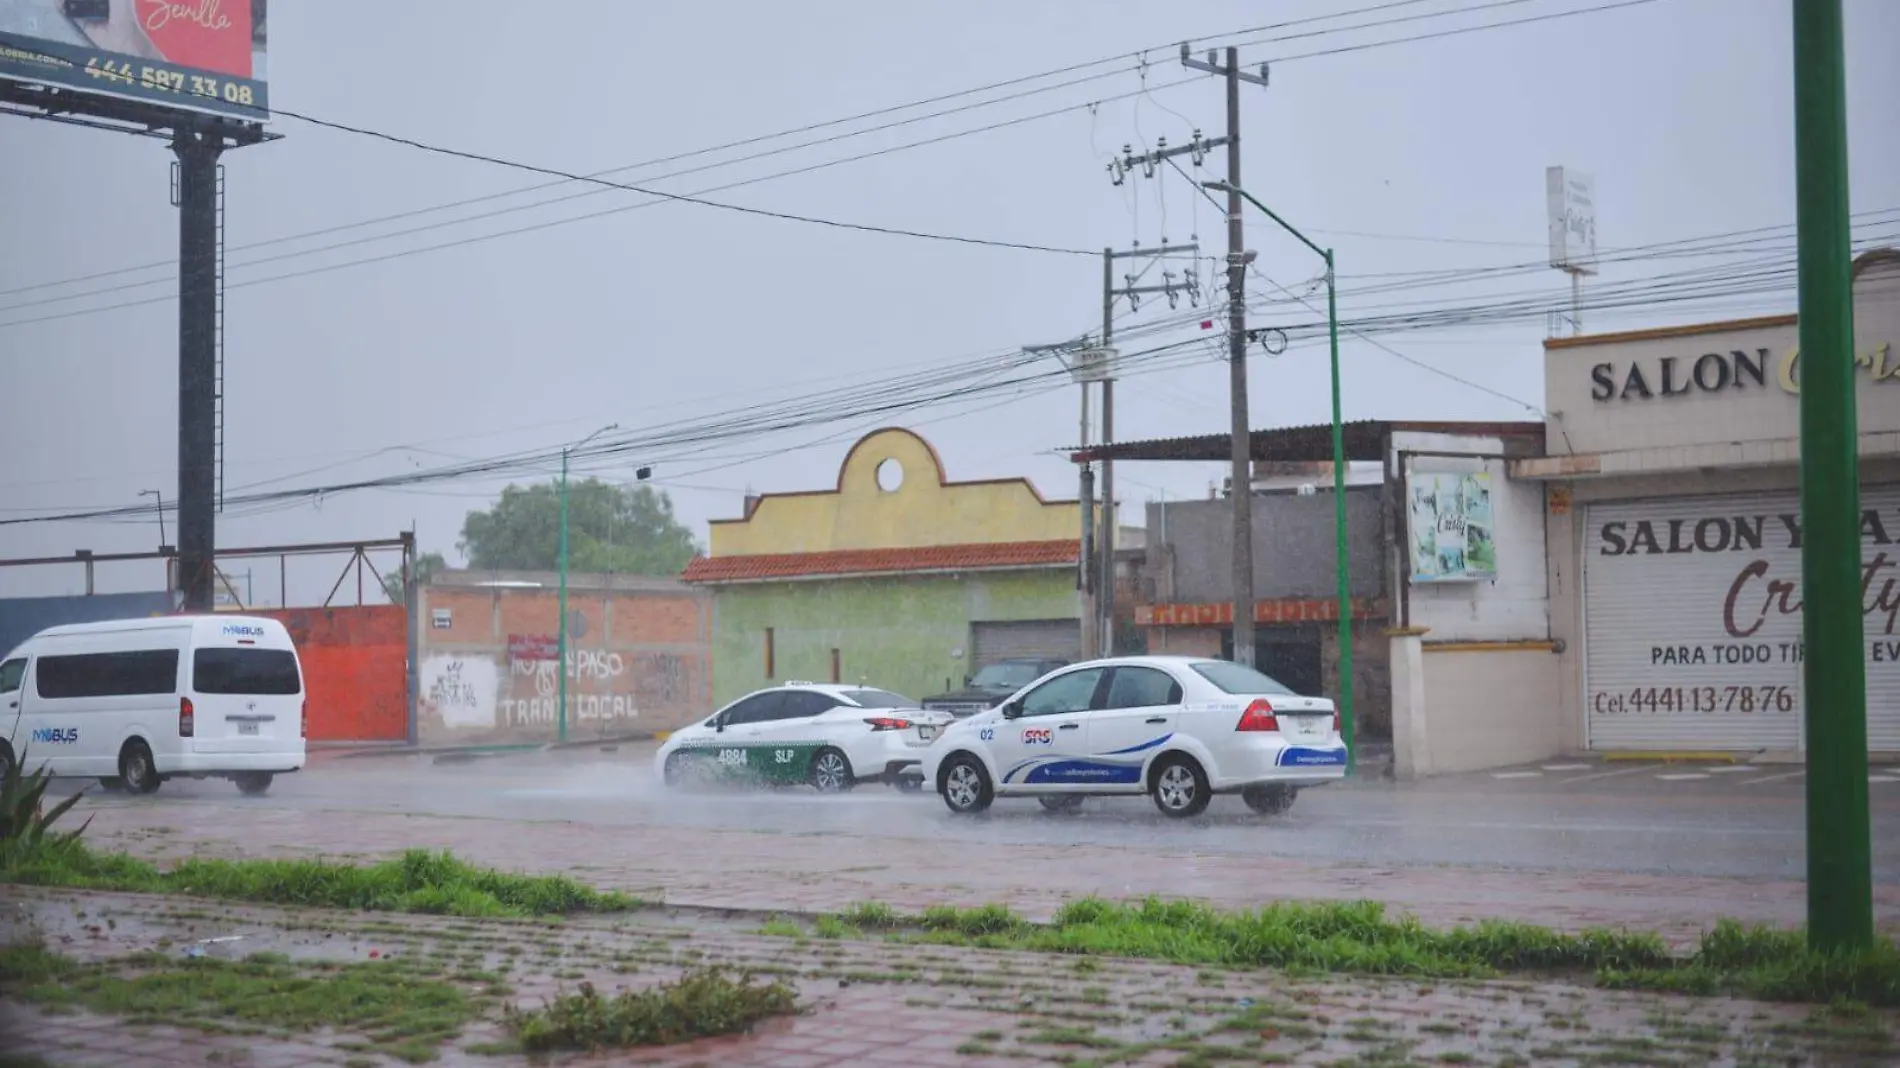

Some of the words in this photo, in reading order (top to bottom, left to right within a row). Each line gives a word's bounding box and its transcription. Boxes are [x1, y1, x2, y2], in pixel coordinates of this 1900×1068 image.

[84, 57, 134, 85] 444
[141, 66, 184, 94] 587
[191, 75, 217, 99] 33
[224, 82, 252, 105] 08
[1591, 348, 1768, 403] SALON
[1600, 515, 1766, 556] SALON
[1723, 551, 1900, 638] Crty
[577, 649, 624, 684] PASO
[1651, 645, 1706, 665] PARA
[1714, 643, 1771, 664] TODO
[577, 694, 638, 719] LOCAL
[980, 729, 994, 740] 02
[775, 749, 794, 764] SLP
